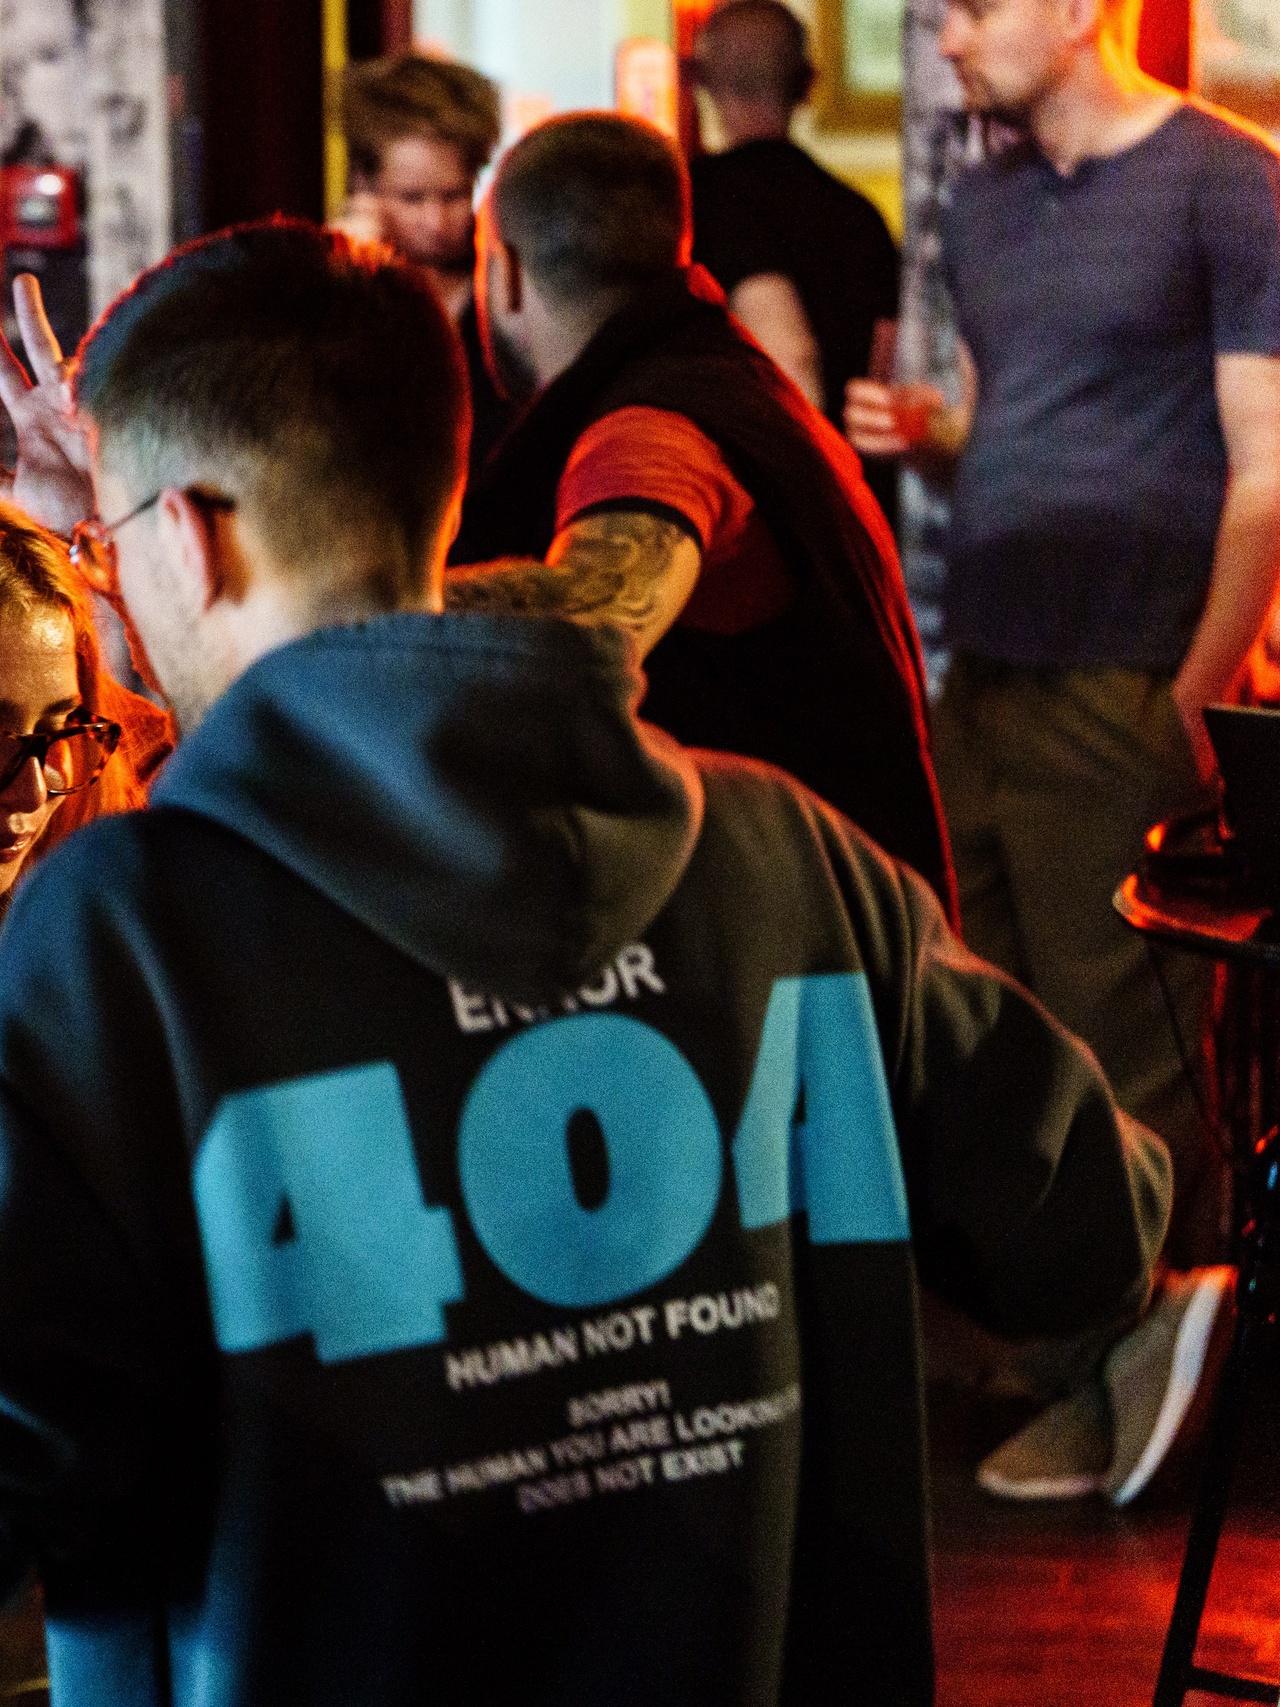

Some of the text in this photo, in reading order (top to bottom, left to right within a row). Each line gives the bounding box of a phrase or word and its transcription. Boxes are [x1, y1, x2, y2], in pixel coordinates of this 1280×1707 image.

[448, 942, 666, 1033] EOR
[193, 971, 910, 1364] 404
[445, 1282, 781, 1391] HUMAN NOT FOUND
[382, 1469, 444, 1507] THE
[445, 1447, 549, 1494] HUMAN
[549, 1431, 607, 1468] YOU
[610, 1415, 671, 1454] ARE
[594, 1456, 655, 1494] NOT
[660, 1439, 744, 1483] EXIST
